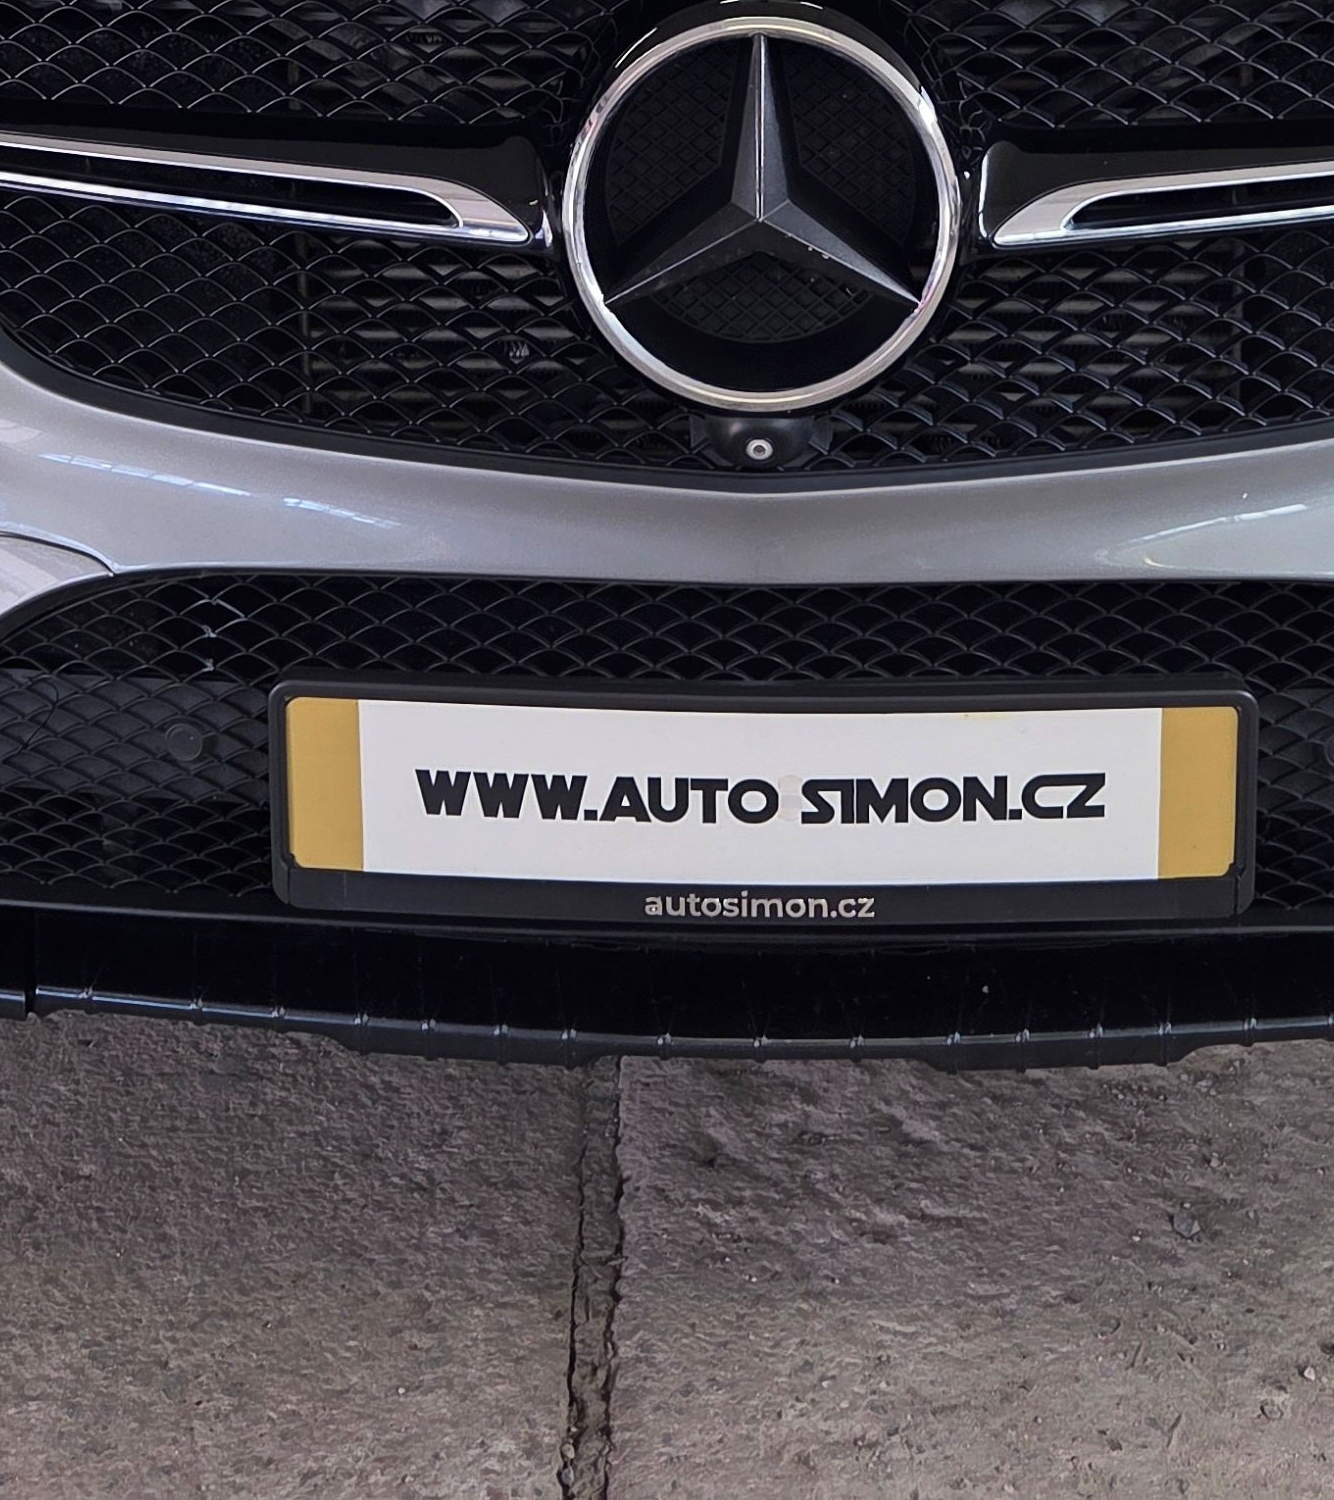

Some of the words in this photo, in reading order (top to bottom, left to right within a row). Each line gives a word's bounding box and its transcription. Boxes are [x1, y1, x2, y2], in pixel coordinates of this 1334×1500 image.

[415, 769, 779, 824] WWW.AUTO
[801, 772, 1106, 825] SIMON.CZ
[644, 890, 875, 918] autosimon.cz
